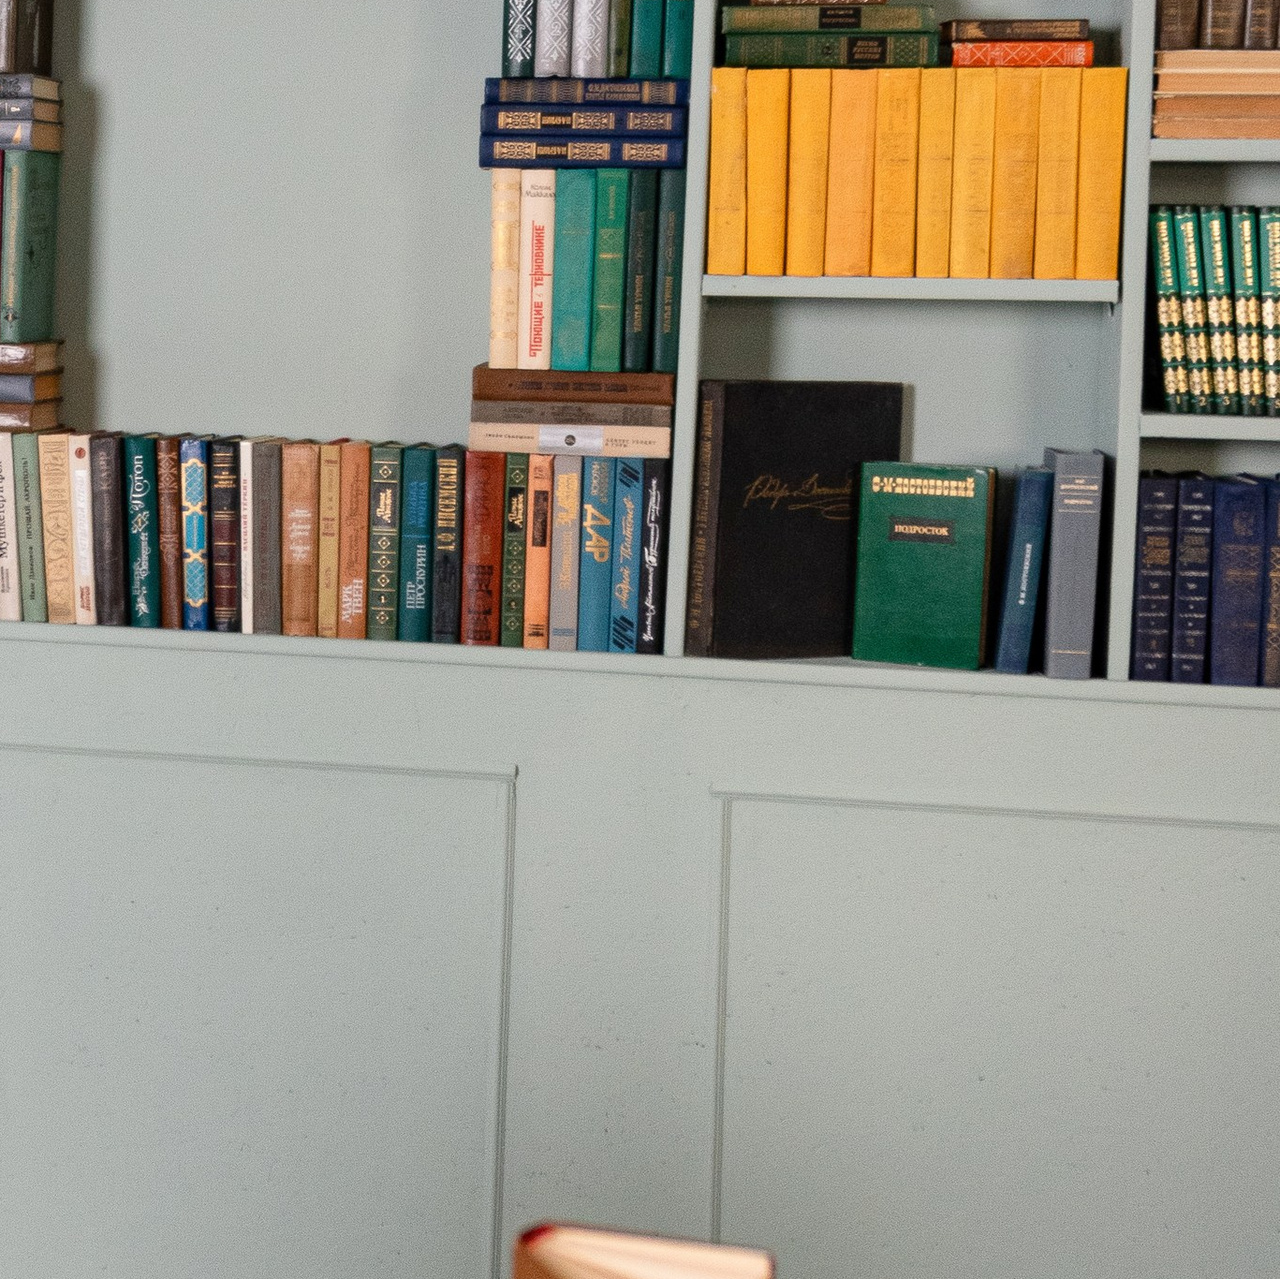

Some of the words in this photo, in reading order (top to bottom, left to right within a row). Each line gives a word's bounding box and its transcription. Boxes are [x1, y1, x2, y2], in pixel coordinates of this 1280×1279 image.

[129, 455, 150, 510] Потоп
[437, 458, 457, 528] ПИСЕМСКИЙ
[583, 504, 610, 562] ДАР
[894, 524, 950, 537] ПОДРОСТОК
[353, 579, 363, 616] ТВЕН
[406, 581, 416, 609] ПЕТР
[415, 544, 427, 609] ПРОСКУРИН
[342, 585, 352, 623] МАРК
